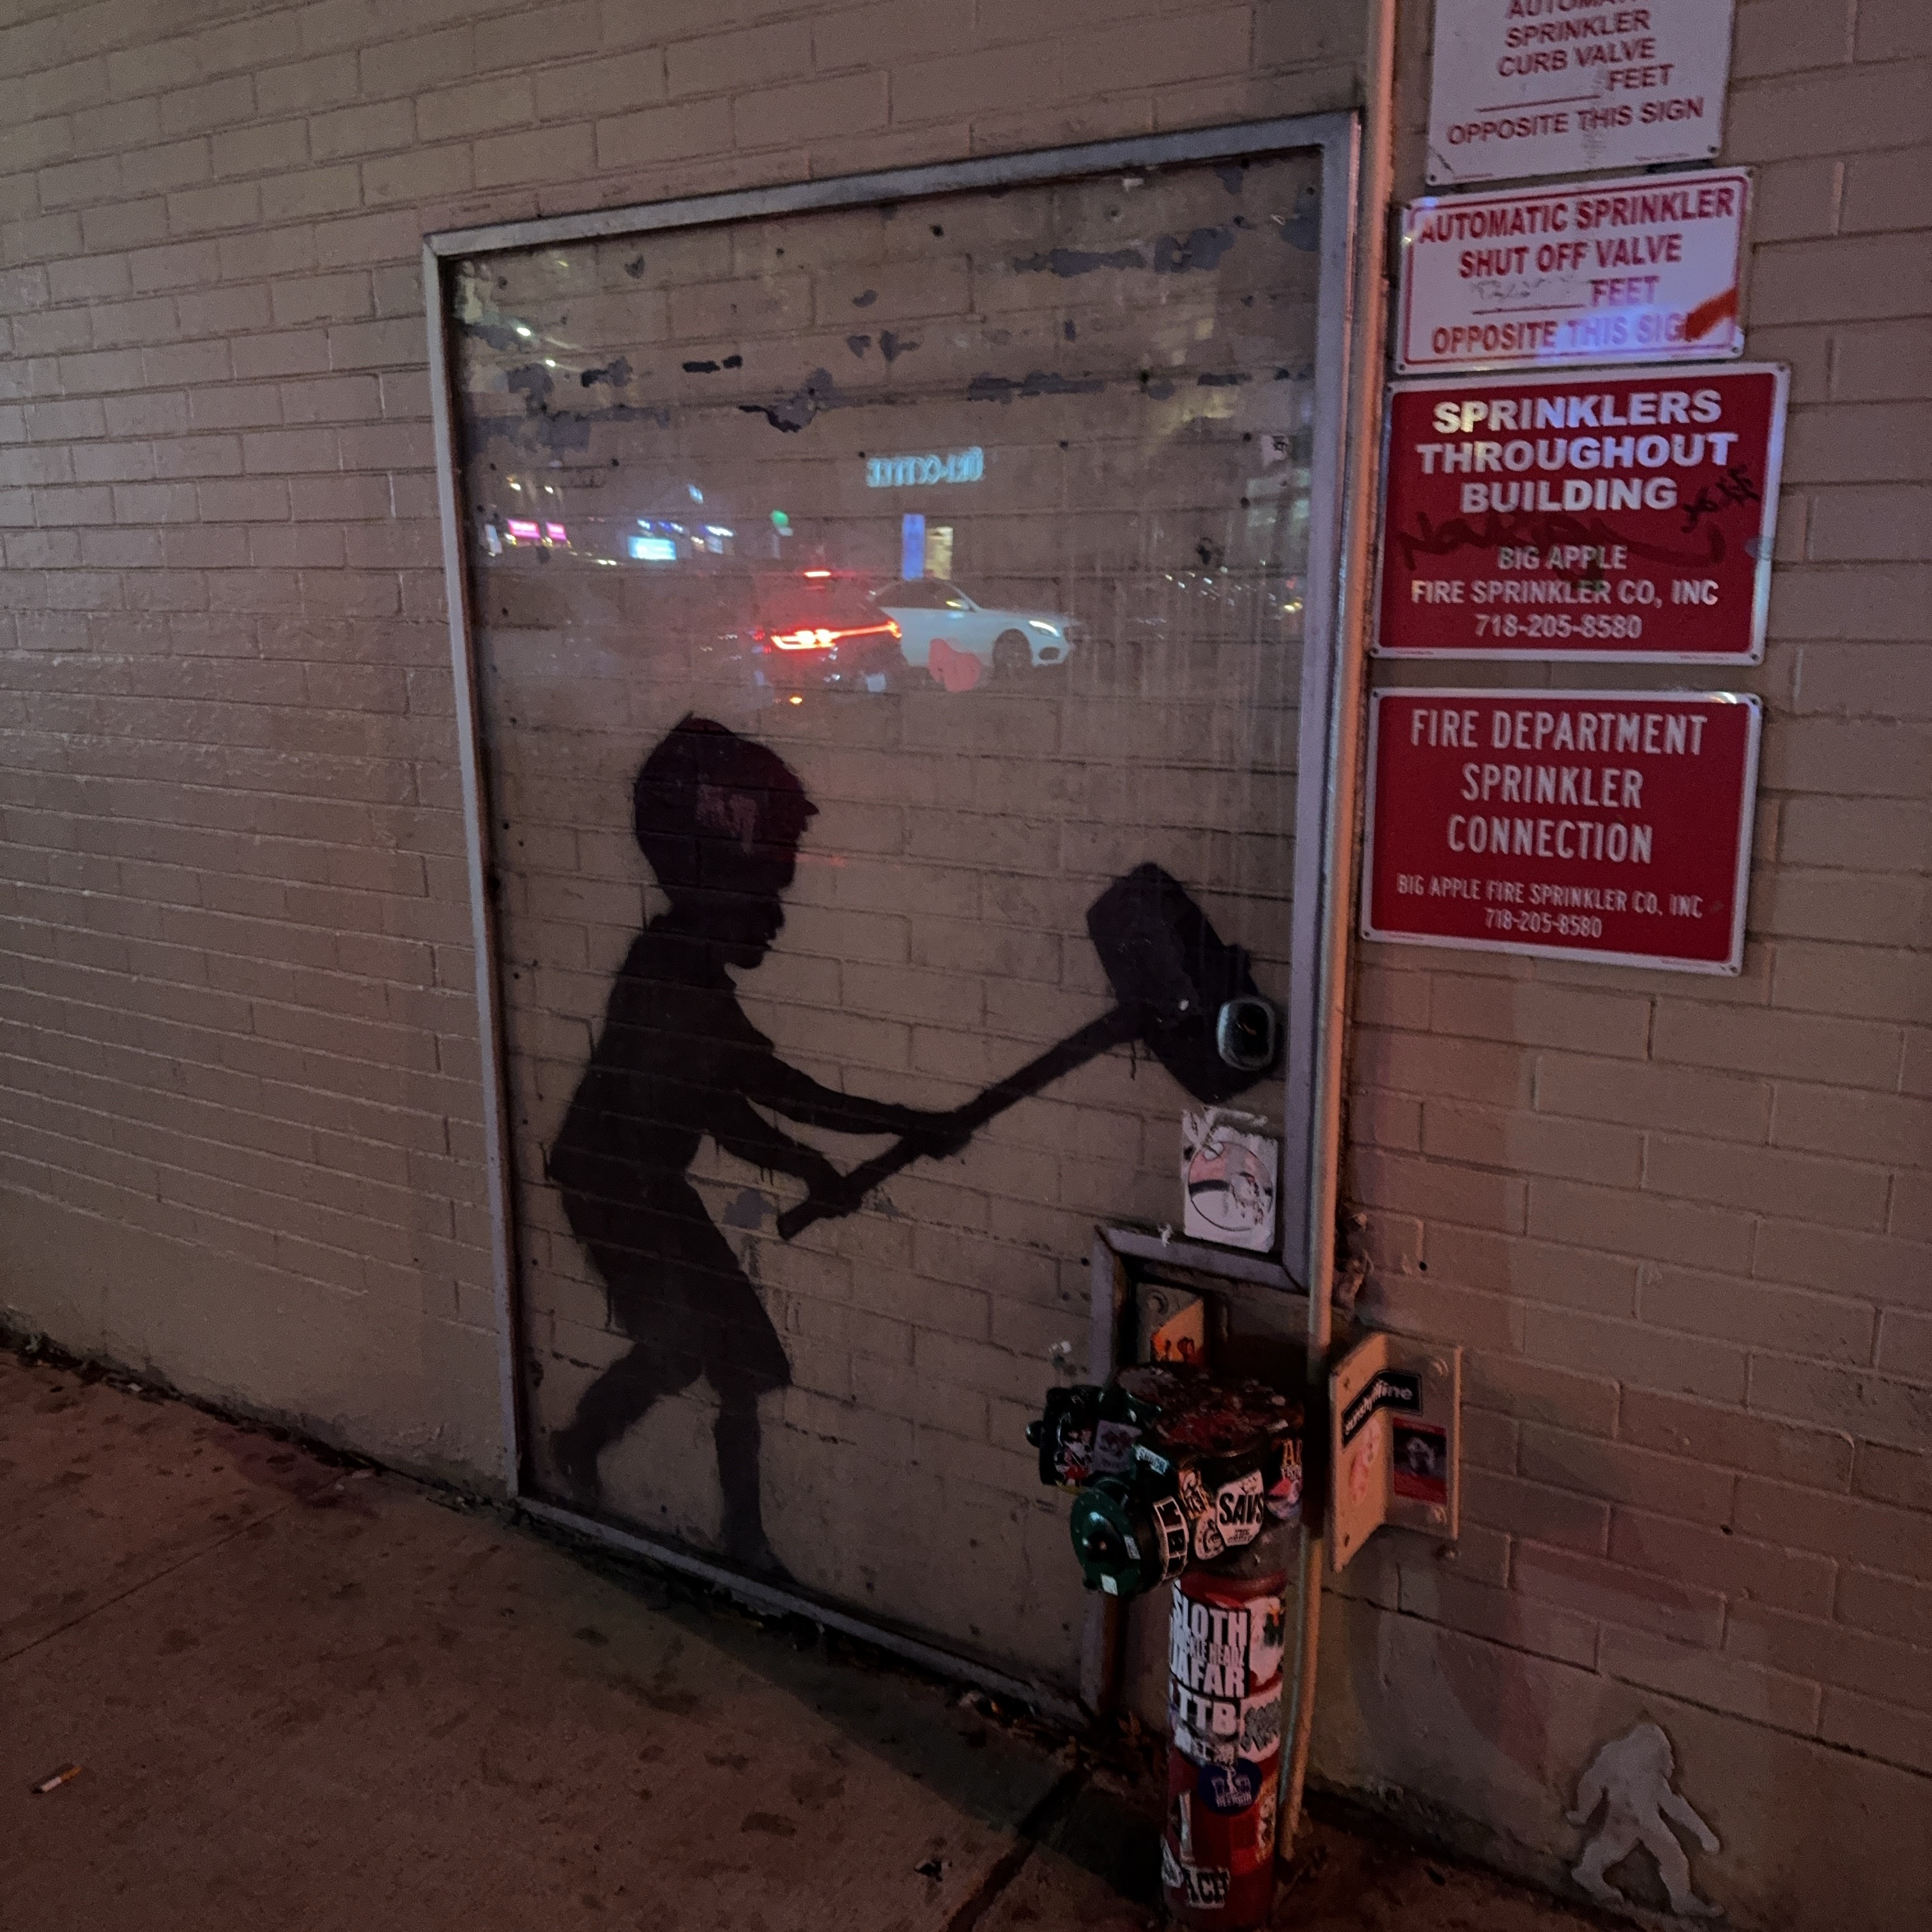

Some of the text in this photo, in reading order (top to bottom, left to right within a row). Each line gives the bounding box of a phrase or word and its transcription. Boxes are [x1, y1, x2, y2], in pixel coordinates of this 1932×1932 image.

[1505, 9, 1650, 49] SPRINKLER
[1497, 37, 1656, 77] CURB VALVE
[1606, 64, 1674, 91] FEET
[1447, 97, 1705, 146] OPPOSITE THIS SIGN
[1419, 188, 1734, 245] AUTOMATIC SPRINKLER
[1459, 233, 1682, 279] SHUT OFF VALVE
[1590, 276, 1659, 308] FEET
[1432, 312, 1694, 355] OPPOSITE THIS SIG
[1433, 389, 1722, 434] SPRINKLERS
[1416, 433, 1738, 474] THROUGHOUT
[1460, 477, 1678, 514] BUILDING
[1498, 544, 1627, 571] BIG APPLE
[1411, 580, 1464, 604] FIRE
[1469, 579, 1611, 604] SPRINKLER
[1671, 580, 1719, 605] INC
[1475, 615, 1642, 639] 718-205-8580
[1410, 709, 1708, 756] FIRE DEPARTMENT
[1462, 763, 1644, 809] SPRINKLER
[1447, 813, 1653, 864] CONNECTION
[1397, 873, 1424, 895] BIG
[1429, 875, 1481, 901] APPLE
[1485, 879, 1524, 903] FIRE
[1529, 882, 1627, 912] SPRINKLER
[1669, 894, 1704, 919] INC
[1484, 907, 1602, 939] 718-205-8580
